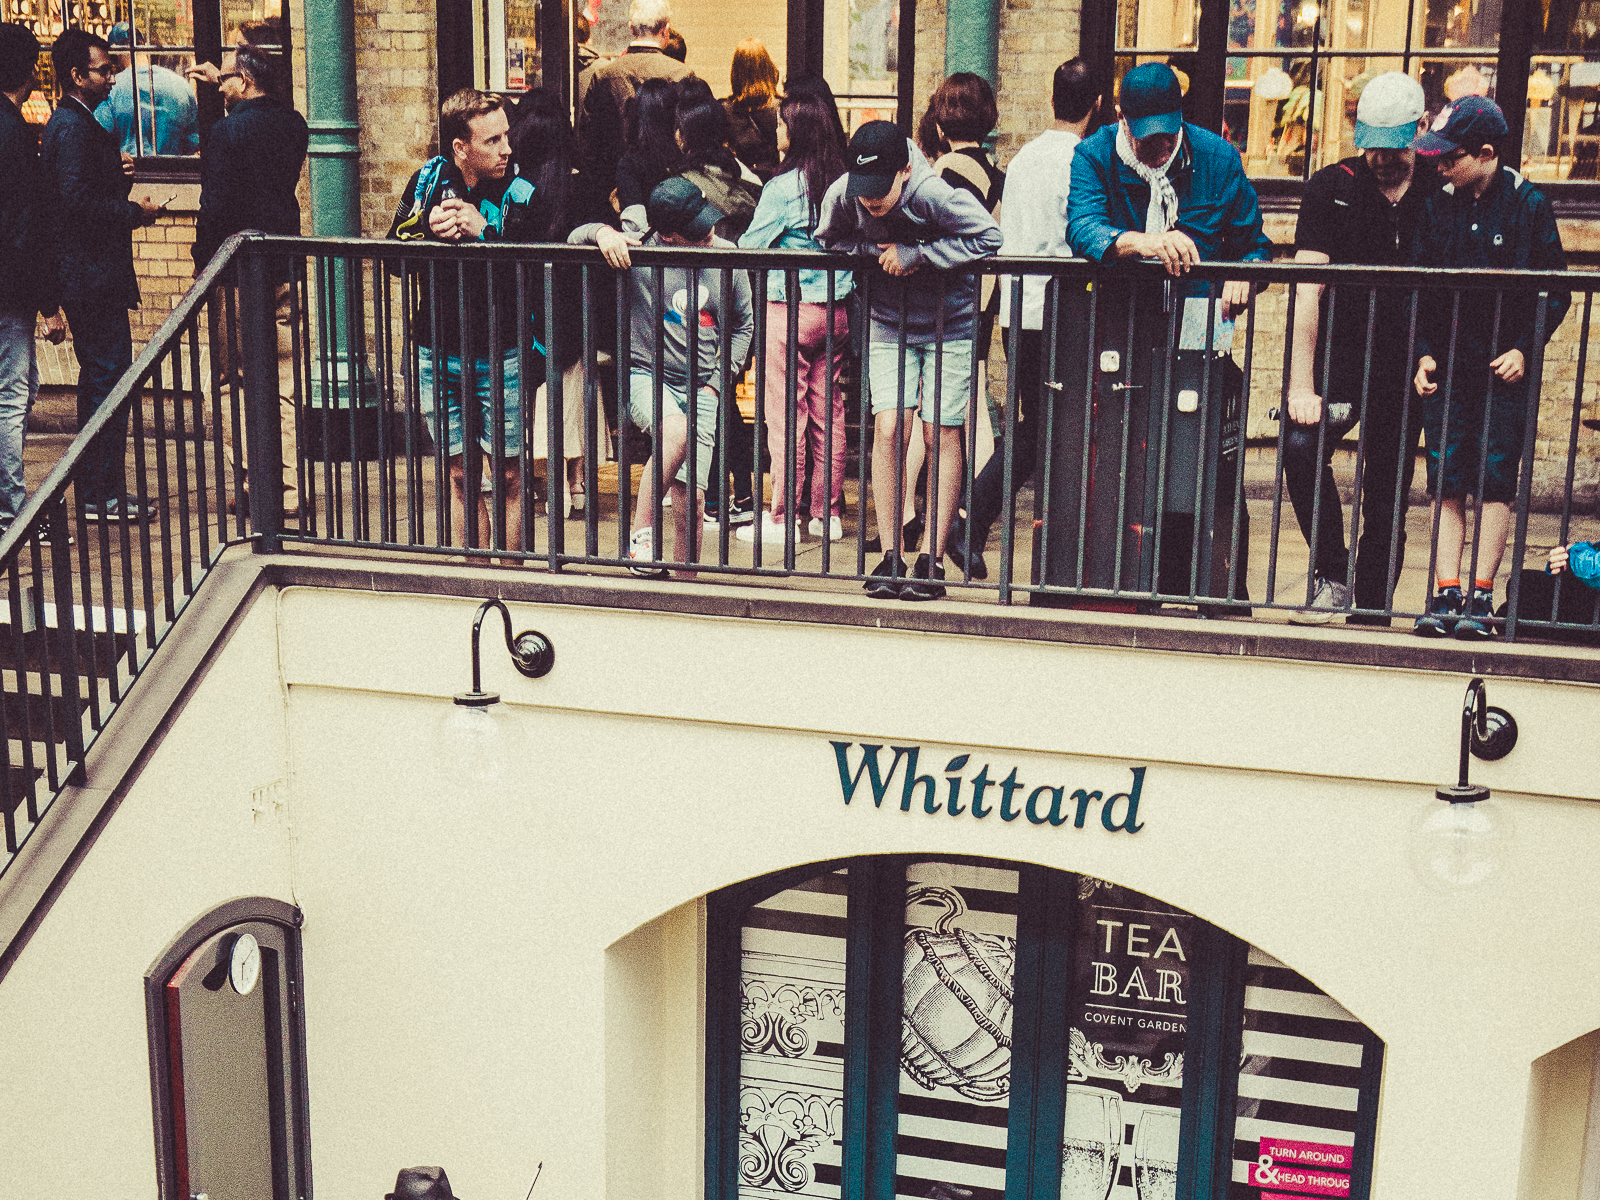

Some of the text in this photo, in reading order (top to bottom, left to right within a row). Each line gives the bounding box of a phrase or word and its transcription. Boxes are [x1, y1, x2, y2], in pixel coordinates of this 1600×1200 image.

[829, 740, 1147, 834] Whittard
[1096, 919, 1187, 962] TEA
[1089, 961, 1187, 1005] BAR
[1084, 1011, 1187, 1033] COVENT GARDEN
[1254, 1154, 1350, 1190] & HEAD THROUG
[1269, 1146, 1345, 1164] TURN AROUND
